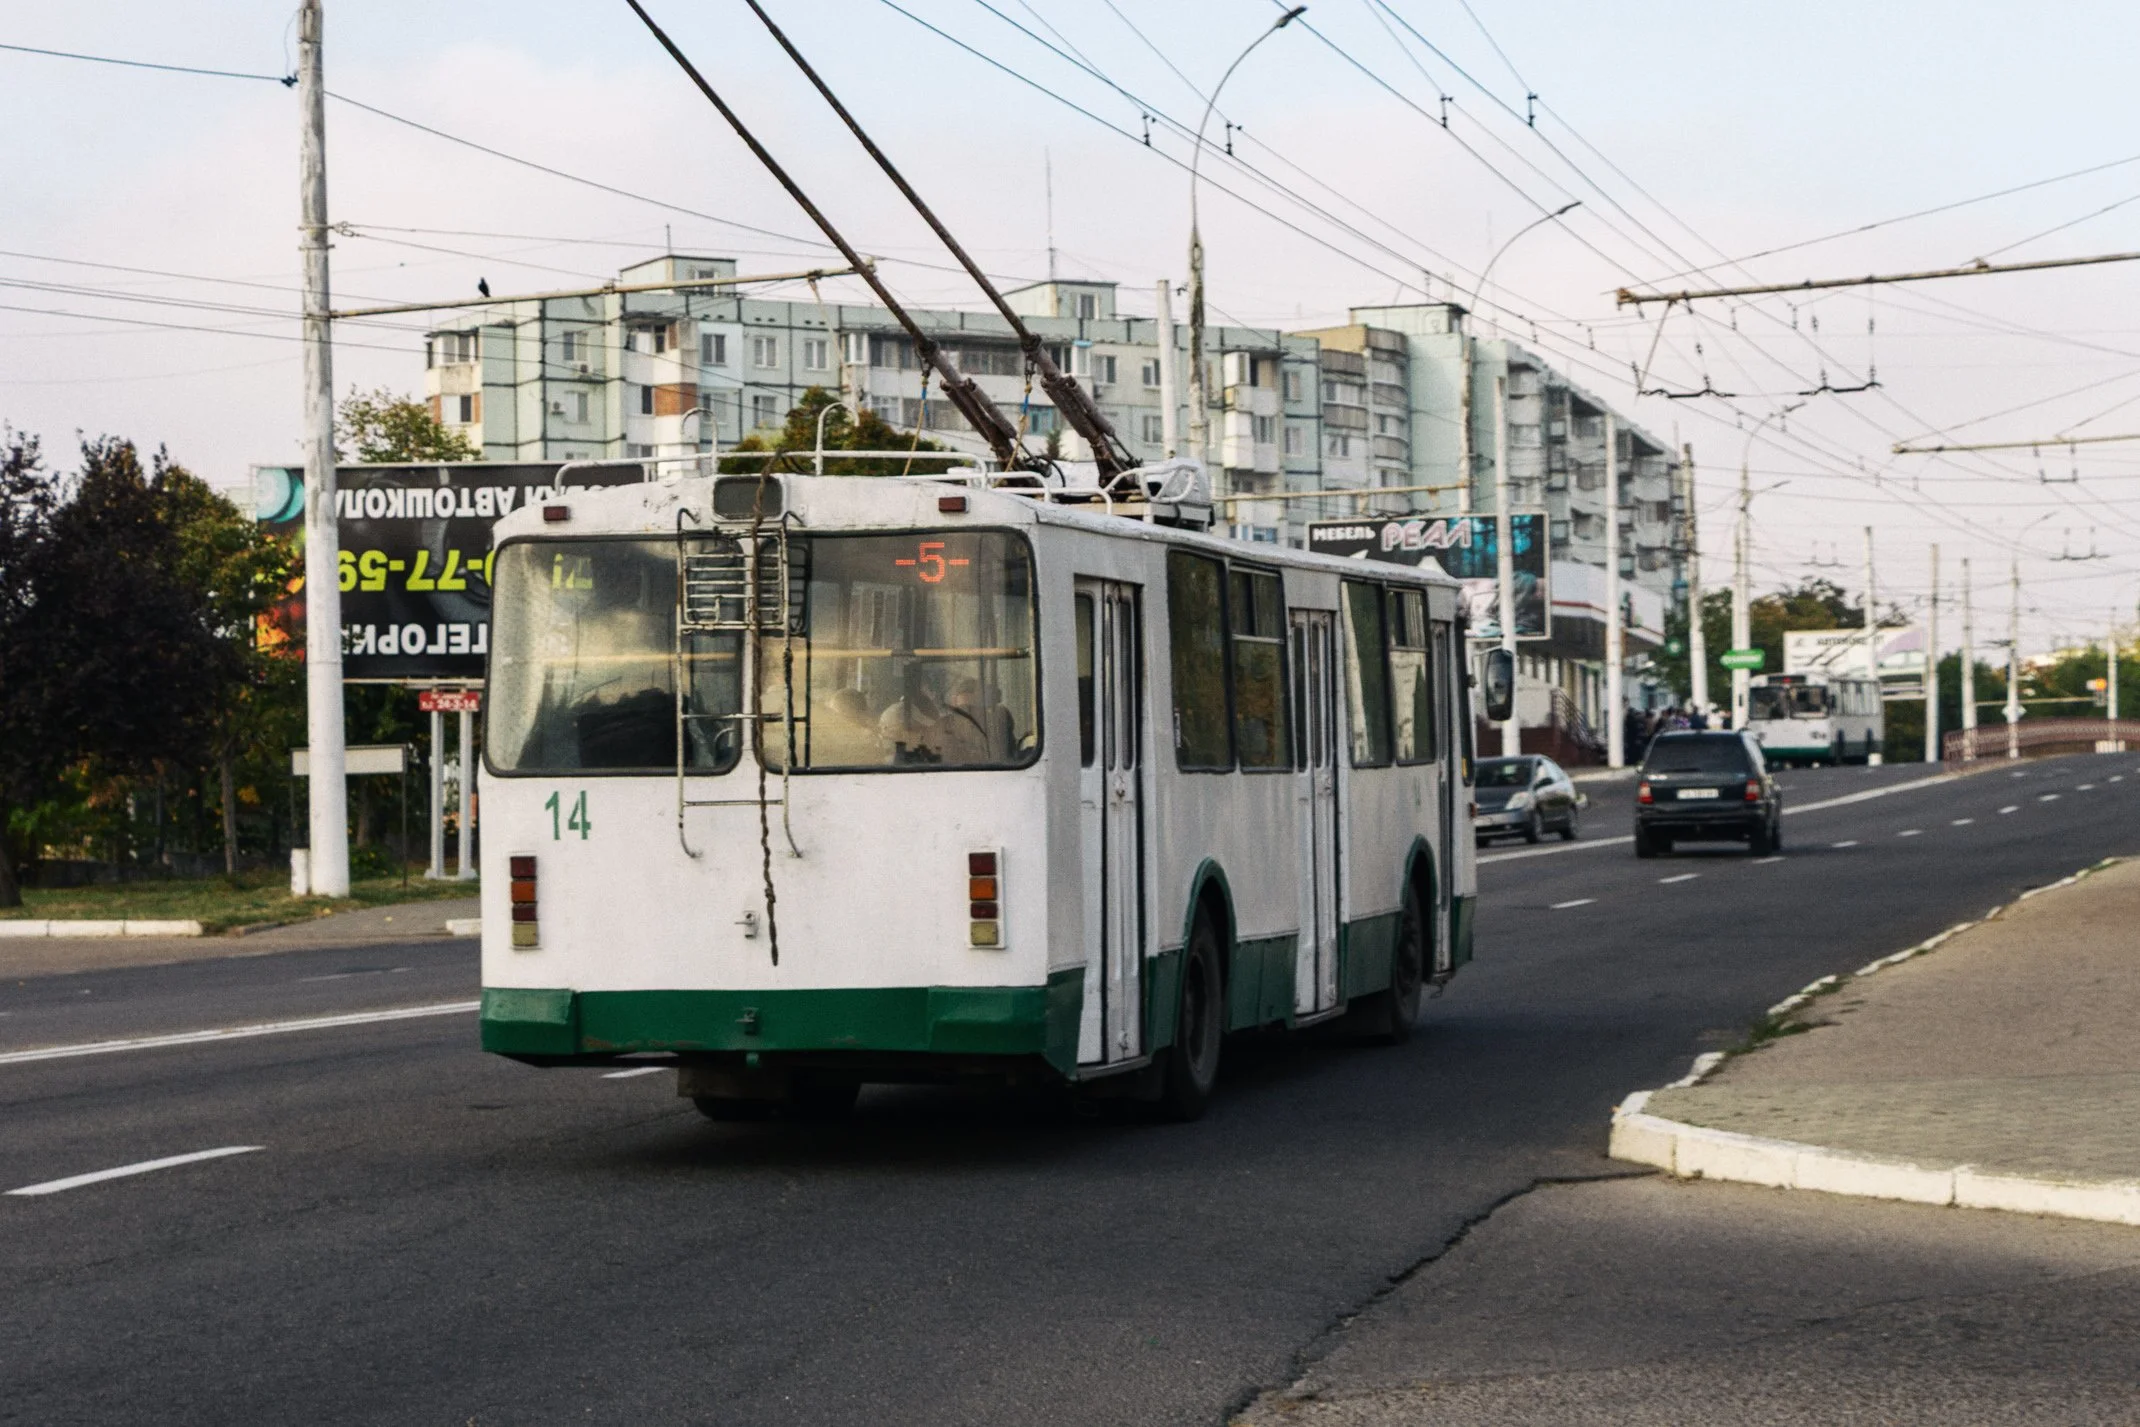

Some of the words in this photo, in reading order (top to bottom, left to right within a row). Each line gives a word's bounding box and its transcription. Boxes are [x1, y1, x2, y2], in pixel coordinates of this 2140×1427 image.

[1312, 525, 1376, 542] МЕБЕЛЬ
[1381, 519, 1473, 552] РЕАЛ
[338, 549, 495, 592] -77-59
[341, 622, 487, 656] ТЕГОРИ
[545, 790, 592, 841] 14
